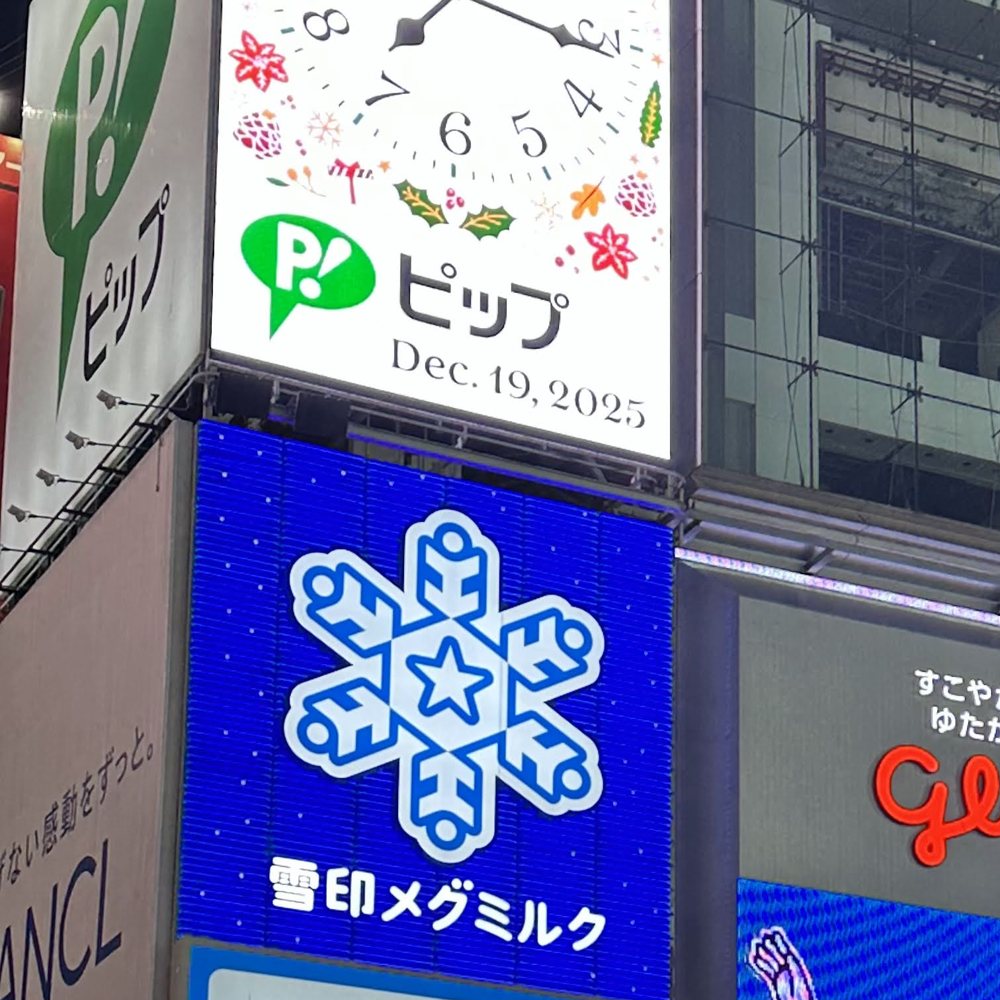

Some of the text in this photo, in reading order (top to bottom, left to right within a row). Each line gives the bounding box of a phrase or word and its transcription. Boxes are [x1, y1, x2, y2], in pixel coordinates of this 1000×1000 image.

[303, 9, 349, 41] 8
[365, 70, 410, 106] 7
[564, 79, 602, 117] 4
[439, 112, 471, 155] 6
[511, 110, 547, 157] 5
[84, 184, 169, 381] ピップ
[400, 253, 569, 350] ピップ
[392, 339, 646, 428] Dec. 19, 2025
[269, 856, 606, 952] 雪印メグミルク
